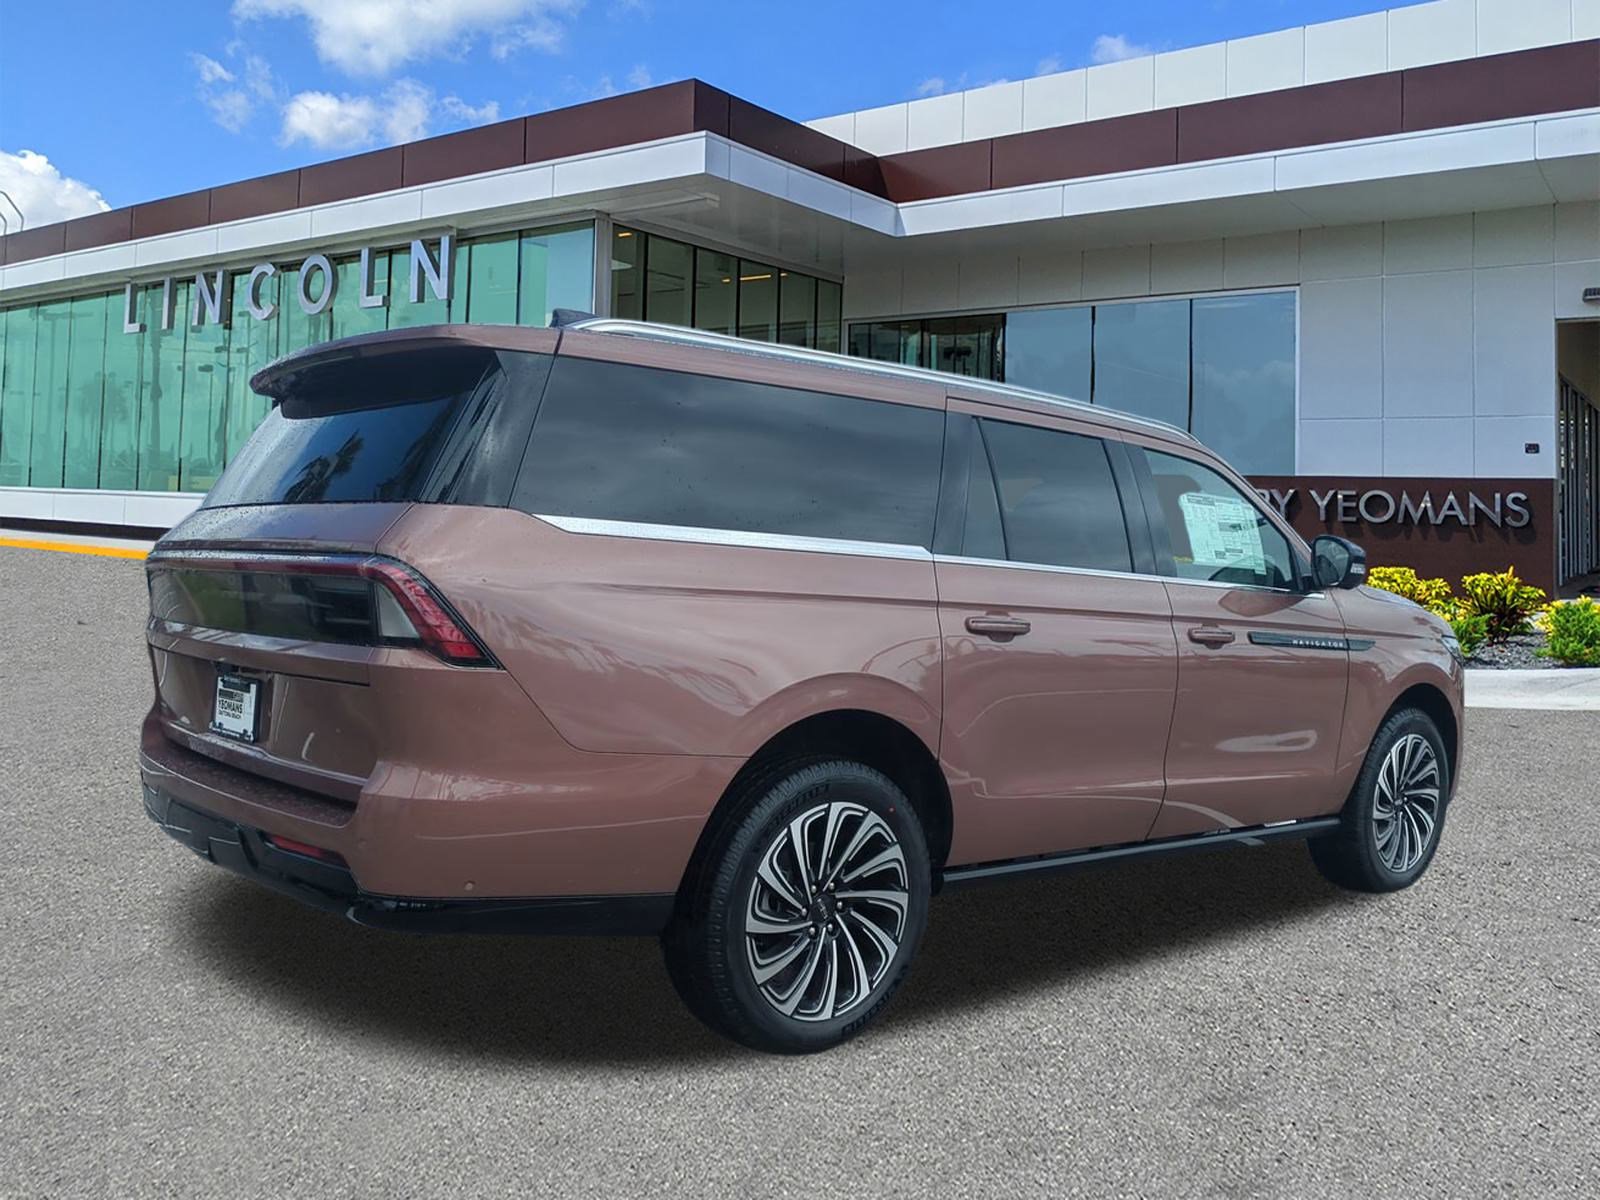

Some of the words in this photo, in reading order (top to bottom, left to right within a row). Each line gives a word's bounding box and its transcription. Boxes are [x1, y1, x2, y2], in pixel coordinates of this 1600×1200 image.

[123, 235, 454, 333] LINCOLN
[1309, 489, 1531, 528] YEOMANS
[1292, 639, 1344, 648] NAVIGATOR
[218, 699, 243, 714] YEOMANS
